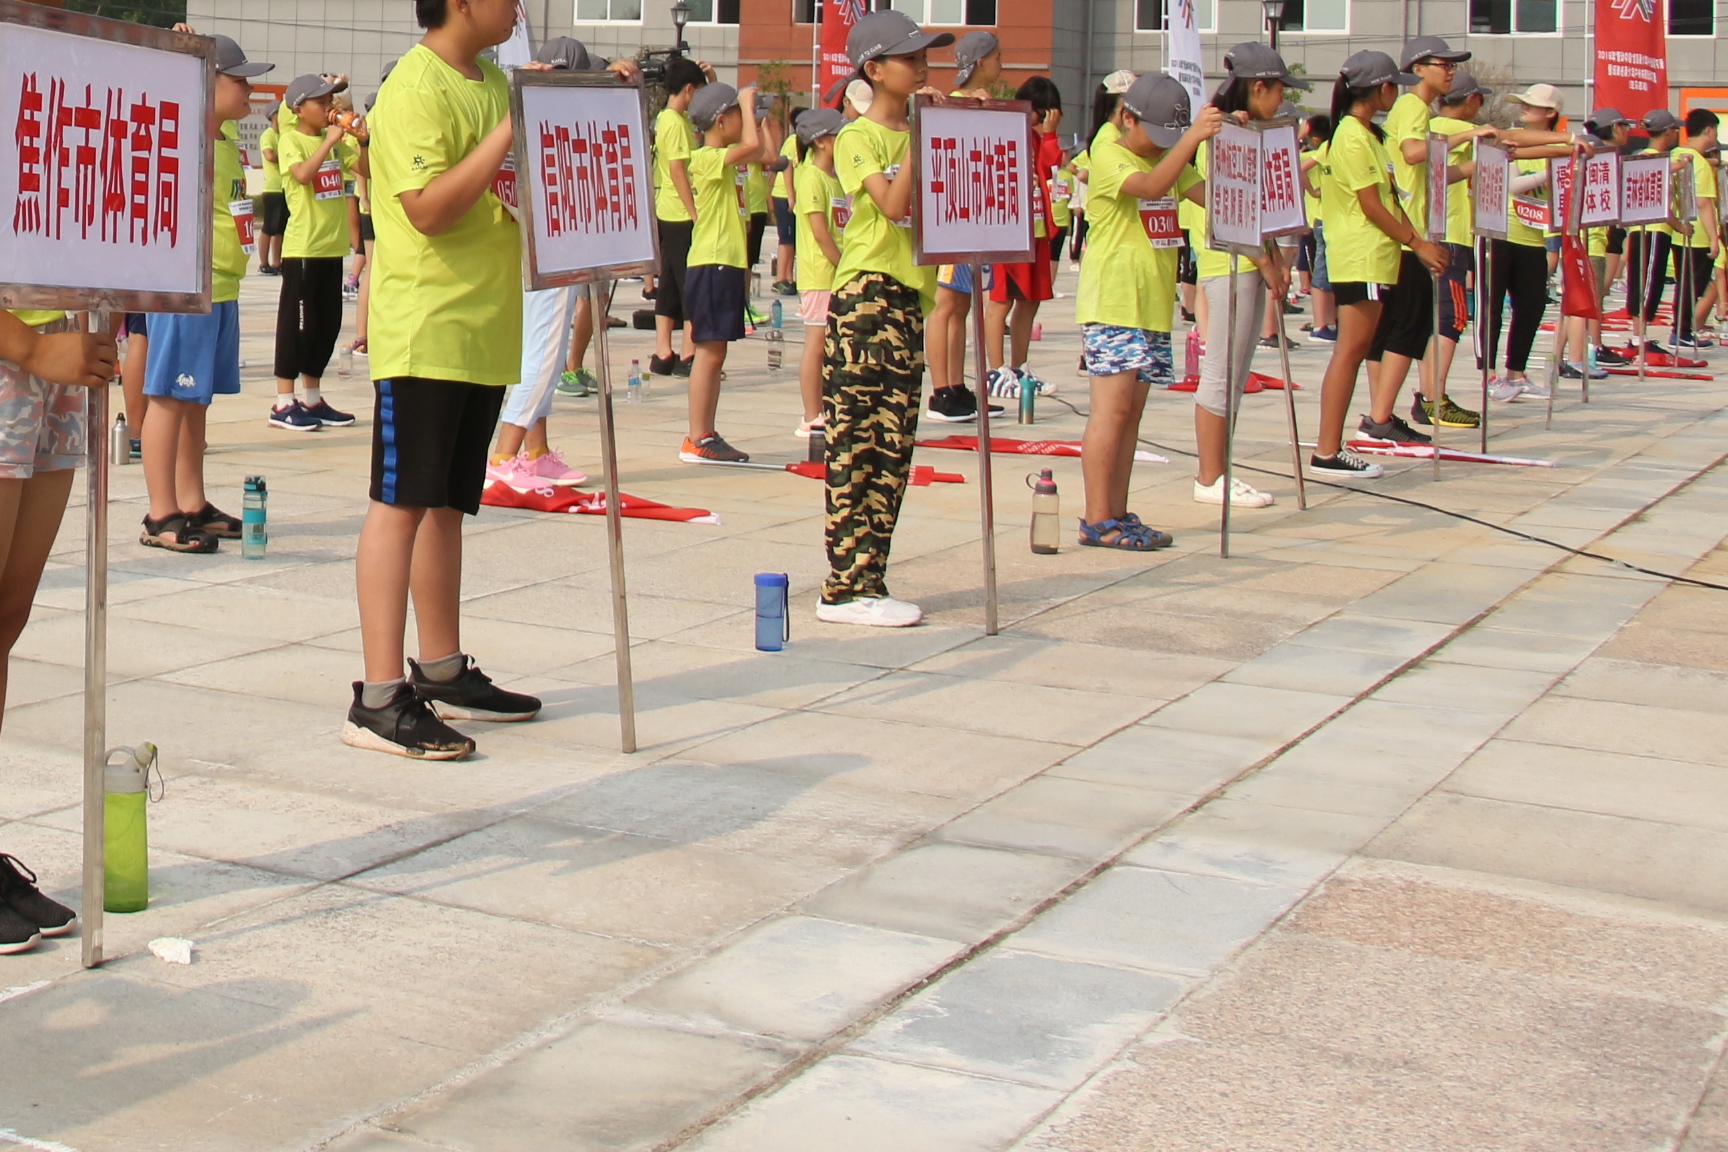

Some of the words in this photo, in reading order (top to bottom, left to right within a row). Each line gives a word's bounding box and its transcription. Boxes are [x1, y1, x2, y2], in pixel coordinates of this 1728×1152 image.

[13, 71, 180, 249] 焦作市体育局
[497, 179, 518, 206] 050
[539, 120, 638, 237] 信阳市体育局
[930, 136, 1020, 226] 平顶山市体育局
[1517, 204, 1544, 221] 0208
